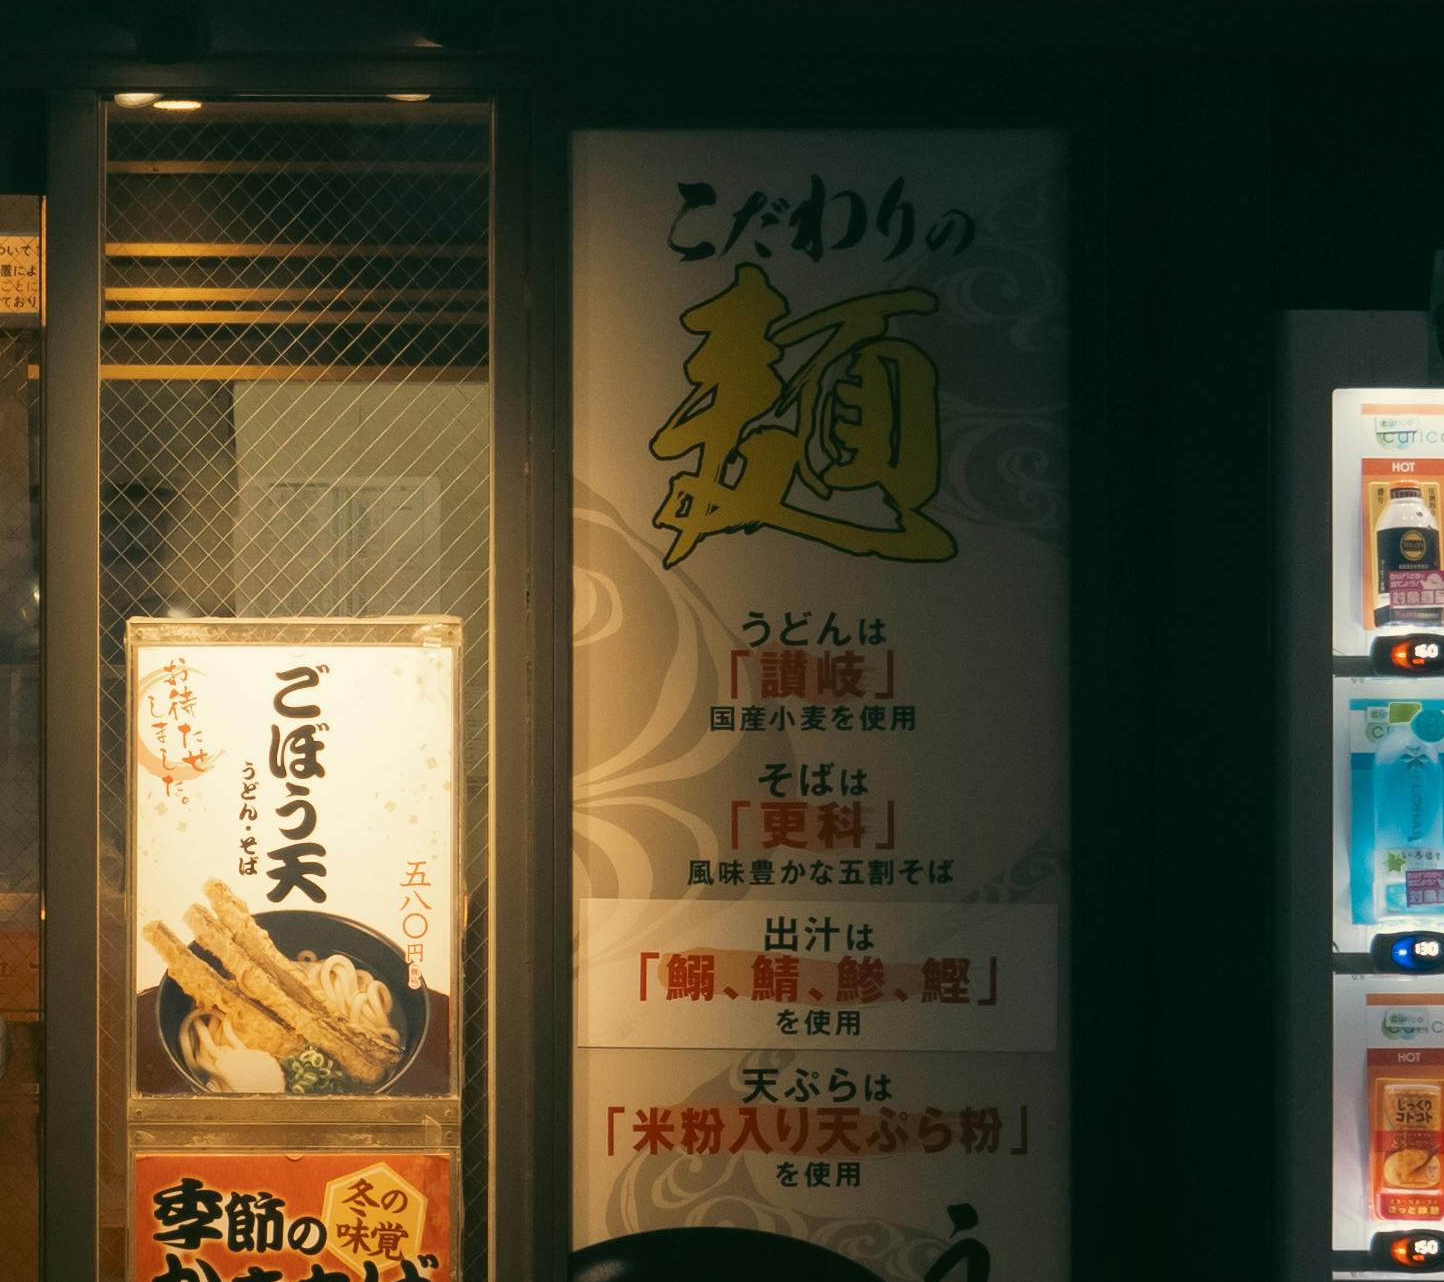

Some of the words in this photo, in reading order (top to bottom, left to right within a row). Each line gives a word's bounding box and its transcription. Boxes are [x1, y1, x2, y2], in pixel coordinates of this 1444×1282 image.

[667, 174, 976, 263] こだわりの
[1392, 461, 1416, 474] HOT
[741, 611, 888, 647] うどんは
[164, 658, 209, 773] お待たせ
[709, 703, 917, 732] 国産小麦を使用
[148, 695, 190, 806] しました。
[265, 663, 331, 905] ごぼう天
[758, 763, 869, 797] そばは
[238, 761, 258, 877] うどん・そば
[730, 799, 896, 851] 「更科」
[687, 858, 955, 887] 風味豊かな五割そば
[764, 916, 875, 952] 出汁は
[775, 1008, 861, 1037] を使用
[1397, 1052, 1421, 1064] HOT
[741, 1067, 892, 1103] 天ぷらは
[1395, 1112, 1433, 1124] コトコト
[1396, 1099, 1433, 1113] じっくり
[607, 1105, 1029, 1157] 「米粉入り天ぷら粉」
[775, 1161, 861, 1187] を使用
[341, 1178, 409, 1217] 冬の
[152, 1177, 328, 1256] 季節の
[337, 1221, 410, 1262] 味覚
